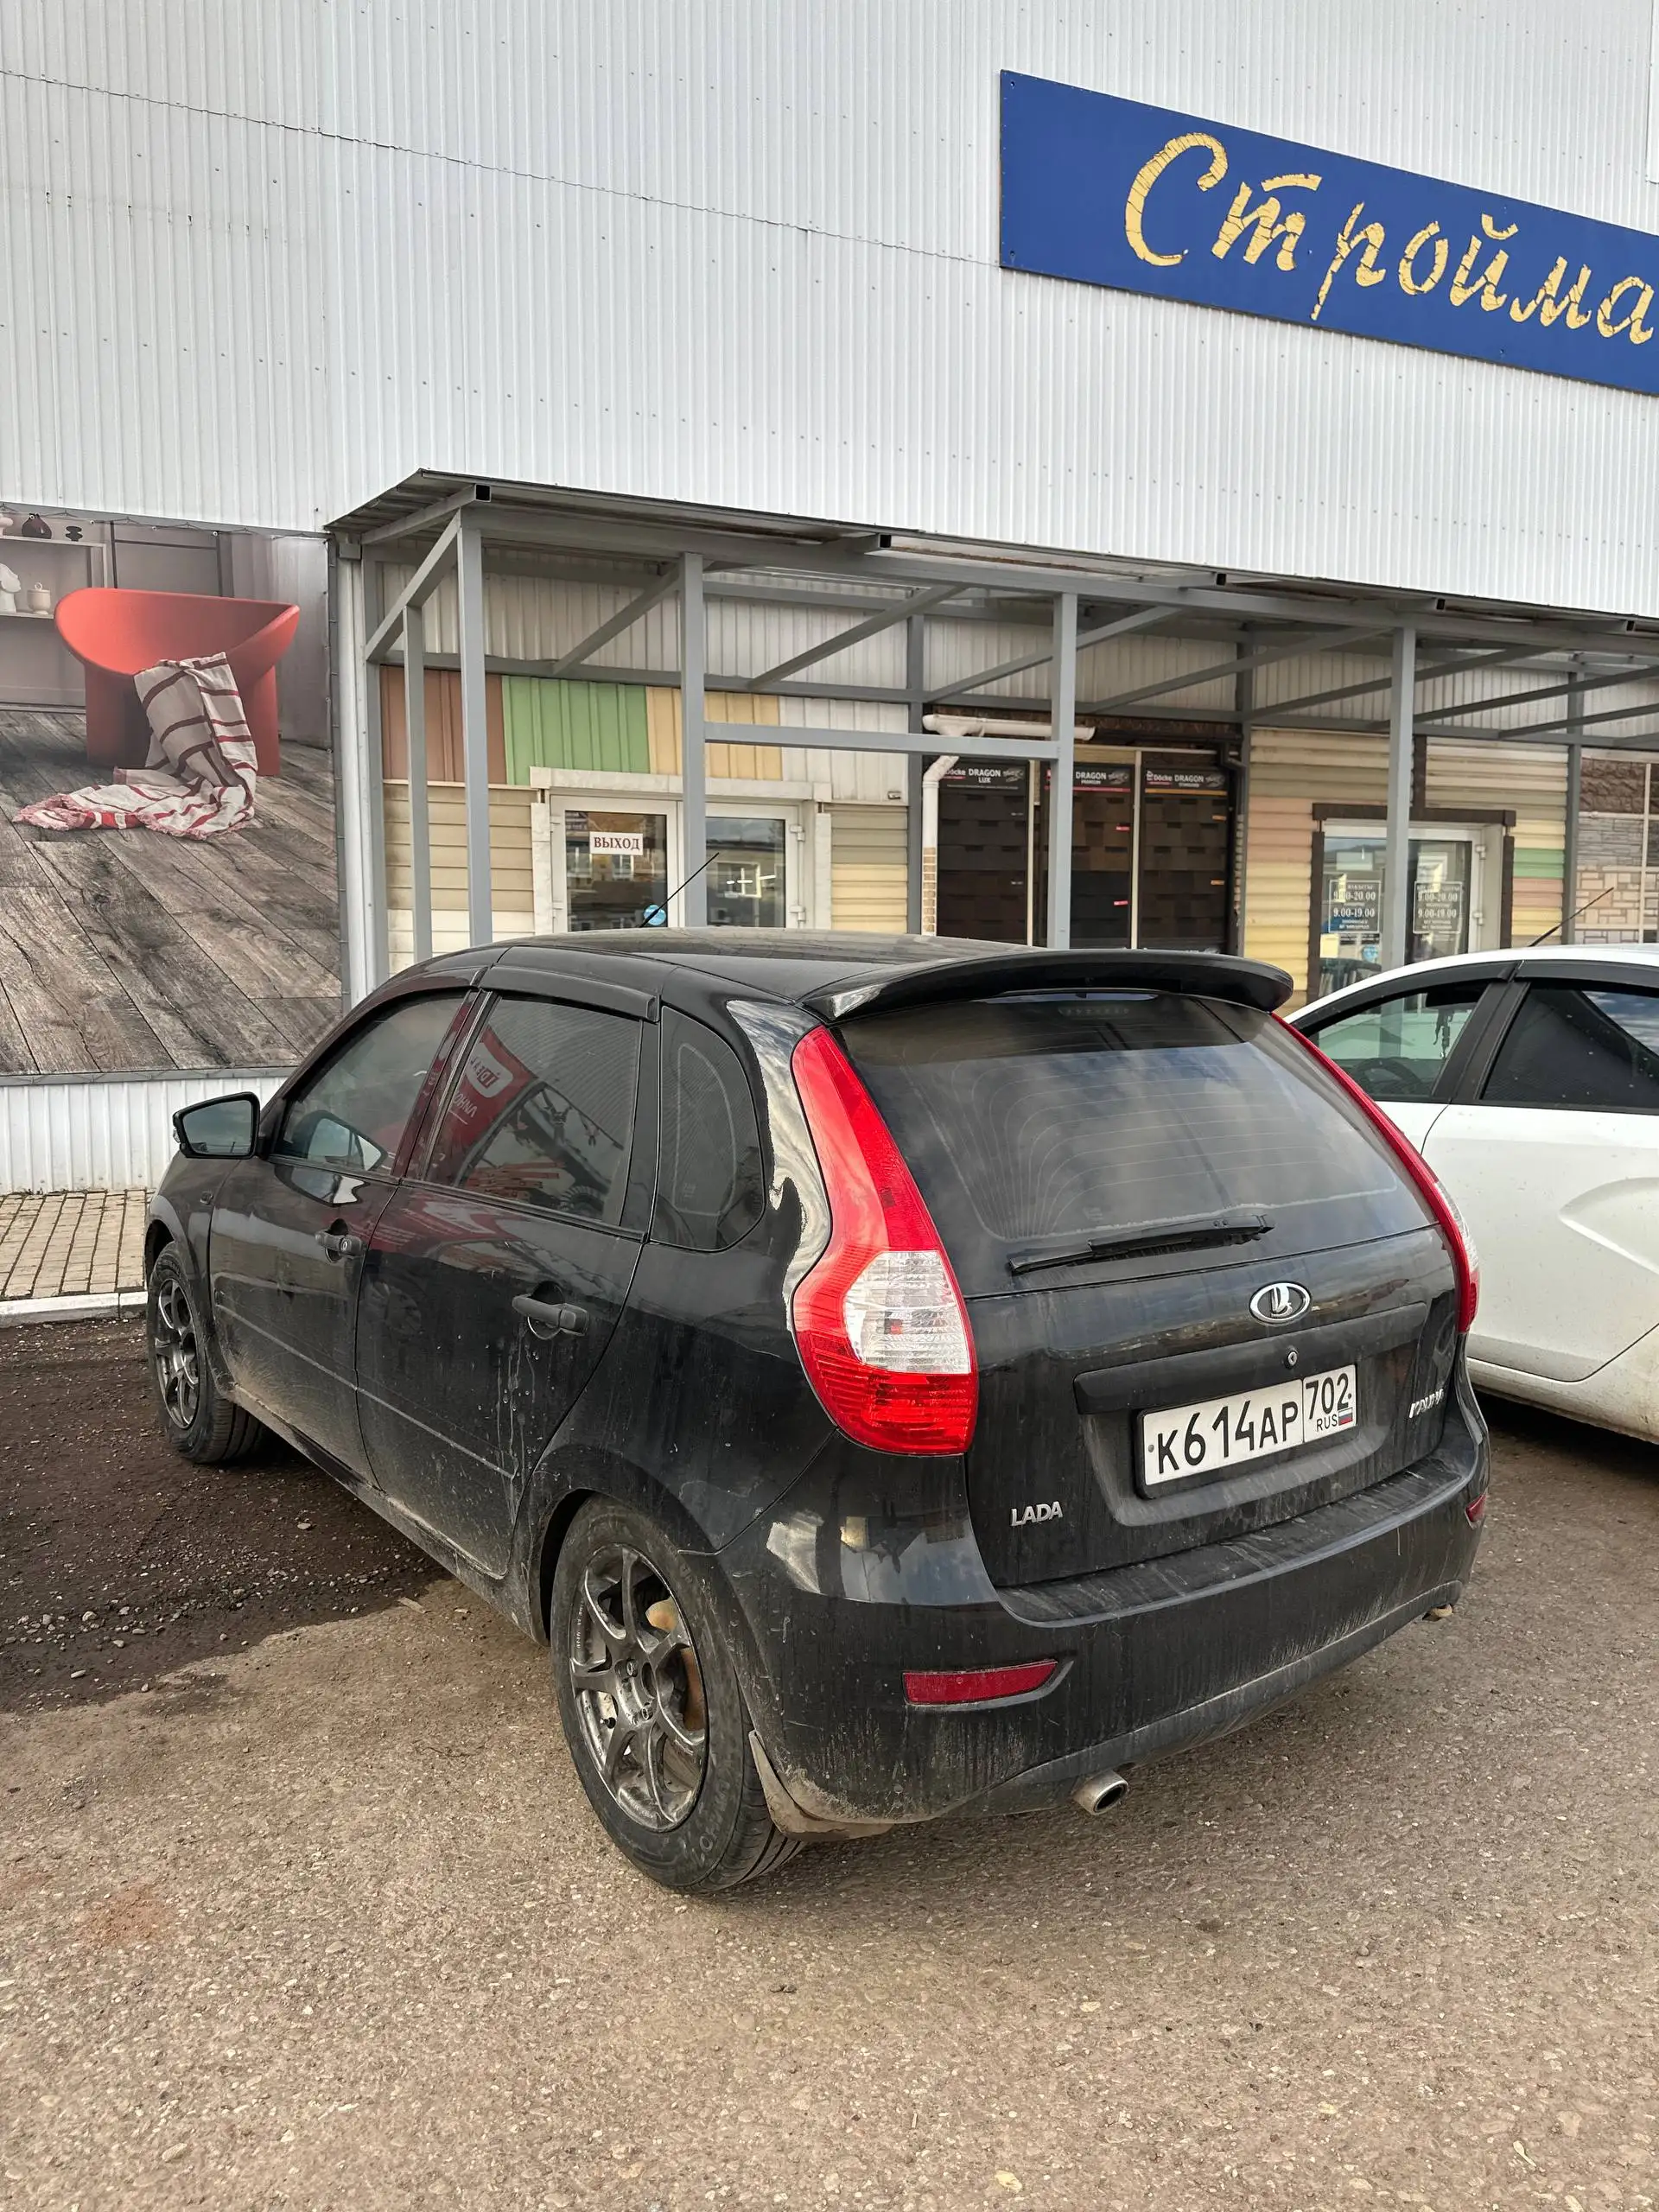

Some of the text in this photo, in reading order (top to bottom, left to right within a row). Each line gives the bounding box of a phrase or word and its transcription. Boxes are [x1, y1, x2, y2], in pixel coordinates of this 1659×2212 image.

[1125, 132, 1656, 344] Стройма
[968, 768, 1001, 778] DRAGON
[1076, 772, 1107, 780] DRAGON
[1174, 774, 1205, 783] DRAGON
[594, 836, 640, 850] ВЫХОД
[1306, 1372, 1349, 1420] 702
[1316, 1414, 1338, 1432] RUS
[1011, 1501, 1063, 1526] LADA
